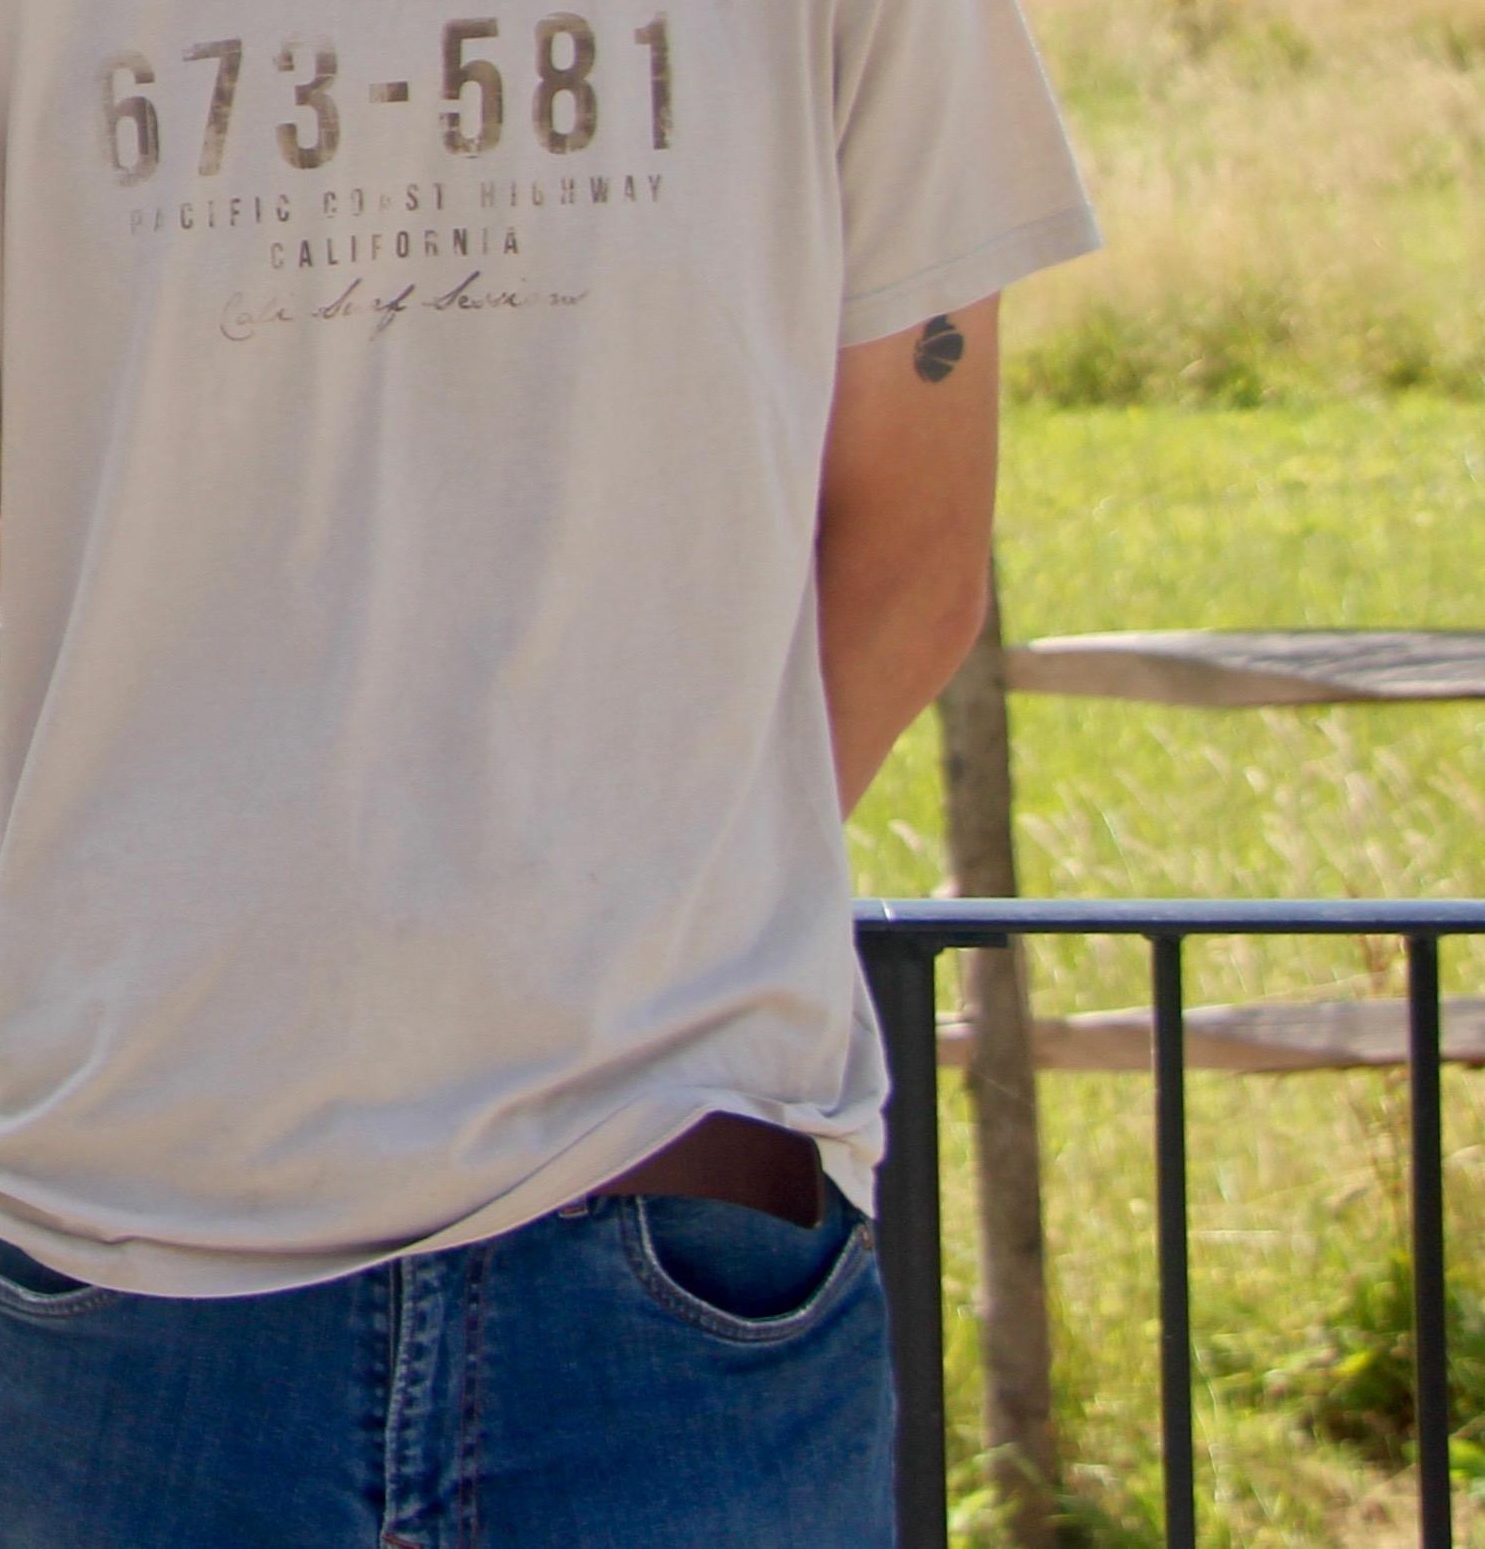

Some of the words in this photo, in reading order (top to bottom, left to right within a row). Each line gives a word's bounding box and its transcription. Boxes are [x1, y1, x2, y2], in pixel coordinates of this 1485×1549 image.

[99, 12, 674, 188] 673-581
[130, 194, 290, 235] PACIFIC
[480, 173, 662, 208] HIGHWAY
[270, 226, 519, 270] CALIFORNIA
